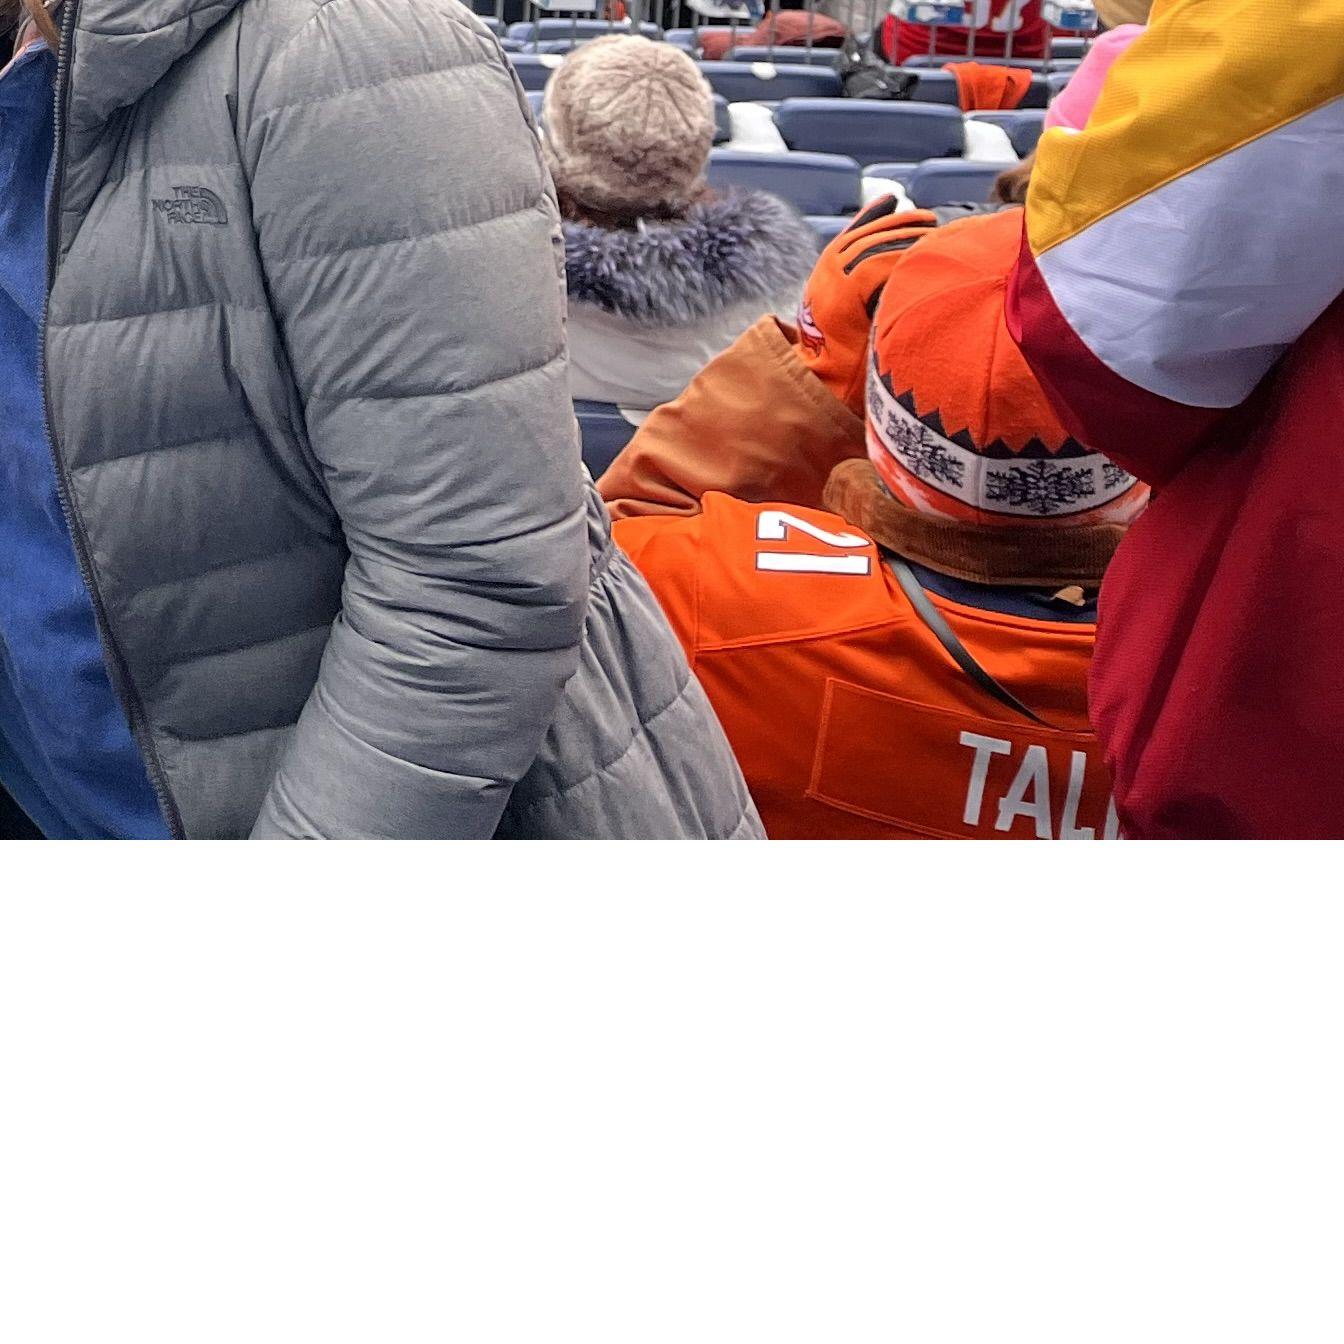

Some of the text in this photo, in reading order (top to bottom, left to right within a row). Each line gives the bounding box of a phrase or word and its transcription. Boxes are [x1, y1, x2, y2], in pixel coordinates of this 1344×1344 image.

[172, 186, 201, 198] THE
[152, 199, 202, 213] NORTH
[167, 212, 202, 225] FACE
[958, 729, 1122, 839] TAL
